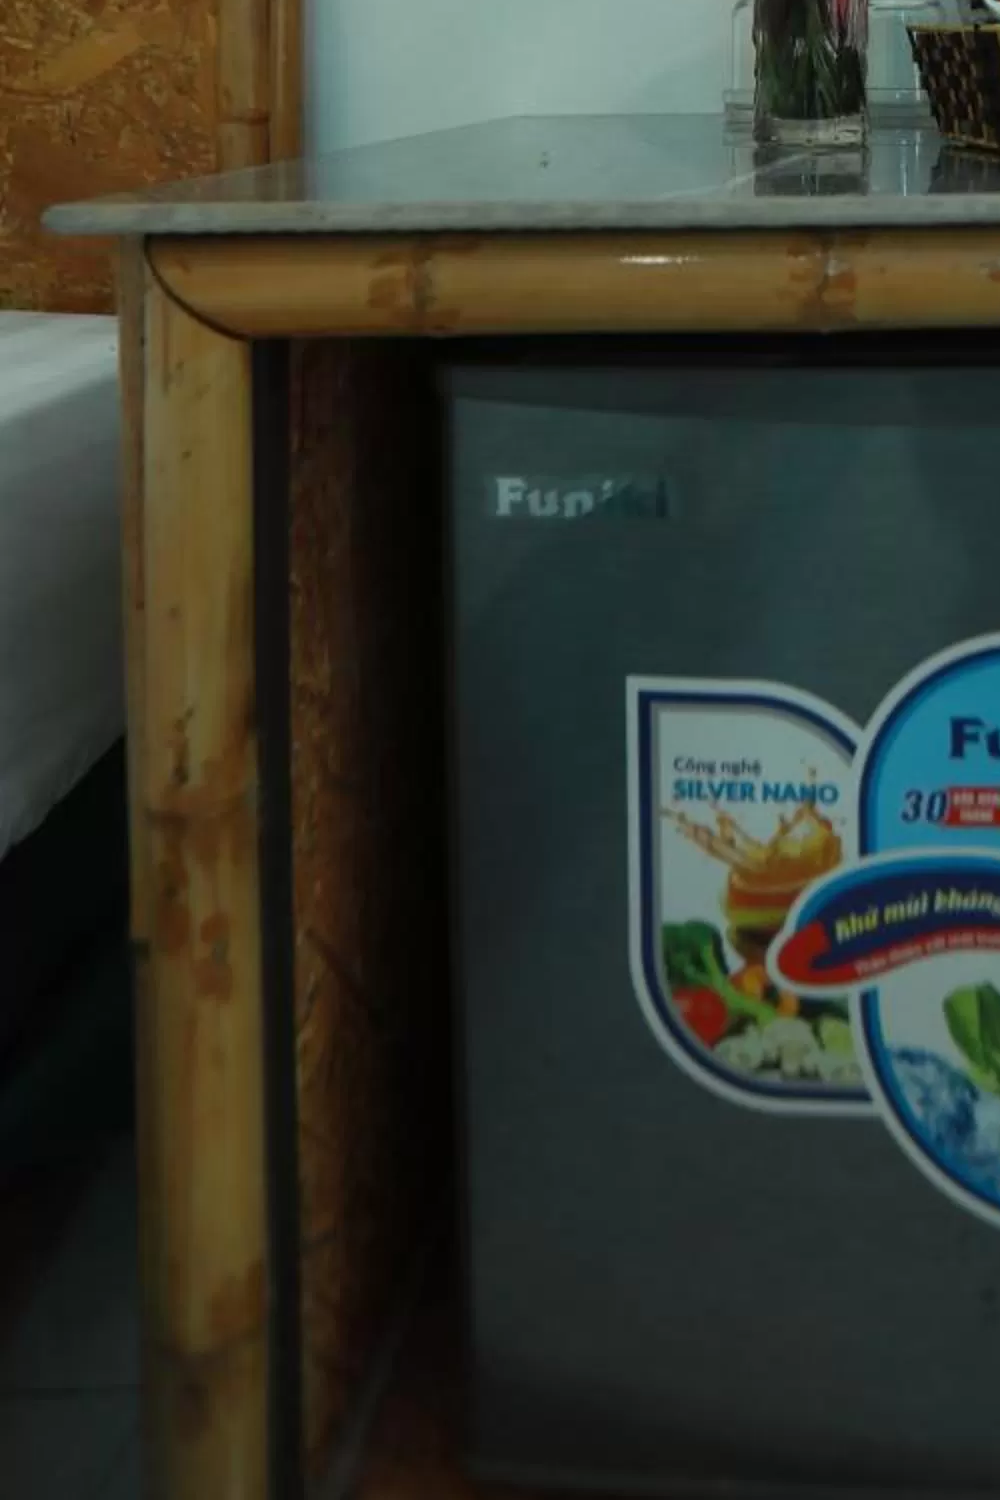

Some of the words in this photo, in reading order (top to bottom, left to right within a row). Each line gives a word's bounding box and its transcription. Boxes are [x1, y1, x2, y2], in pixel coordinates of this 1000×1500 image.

[673, 779, 755, 802] SILVER
[761, 782, 839, 804] NANO
[901, 789, 948, 823] 30
